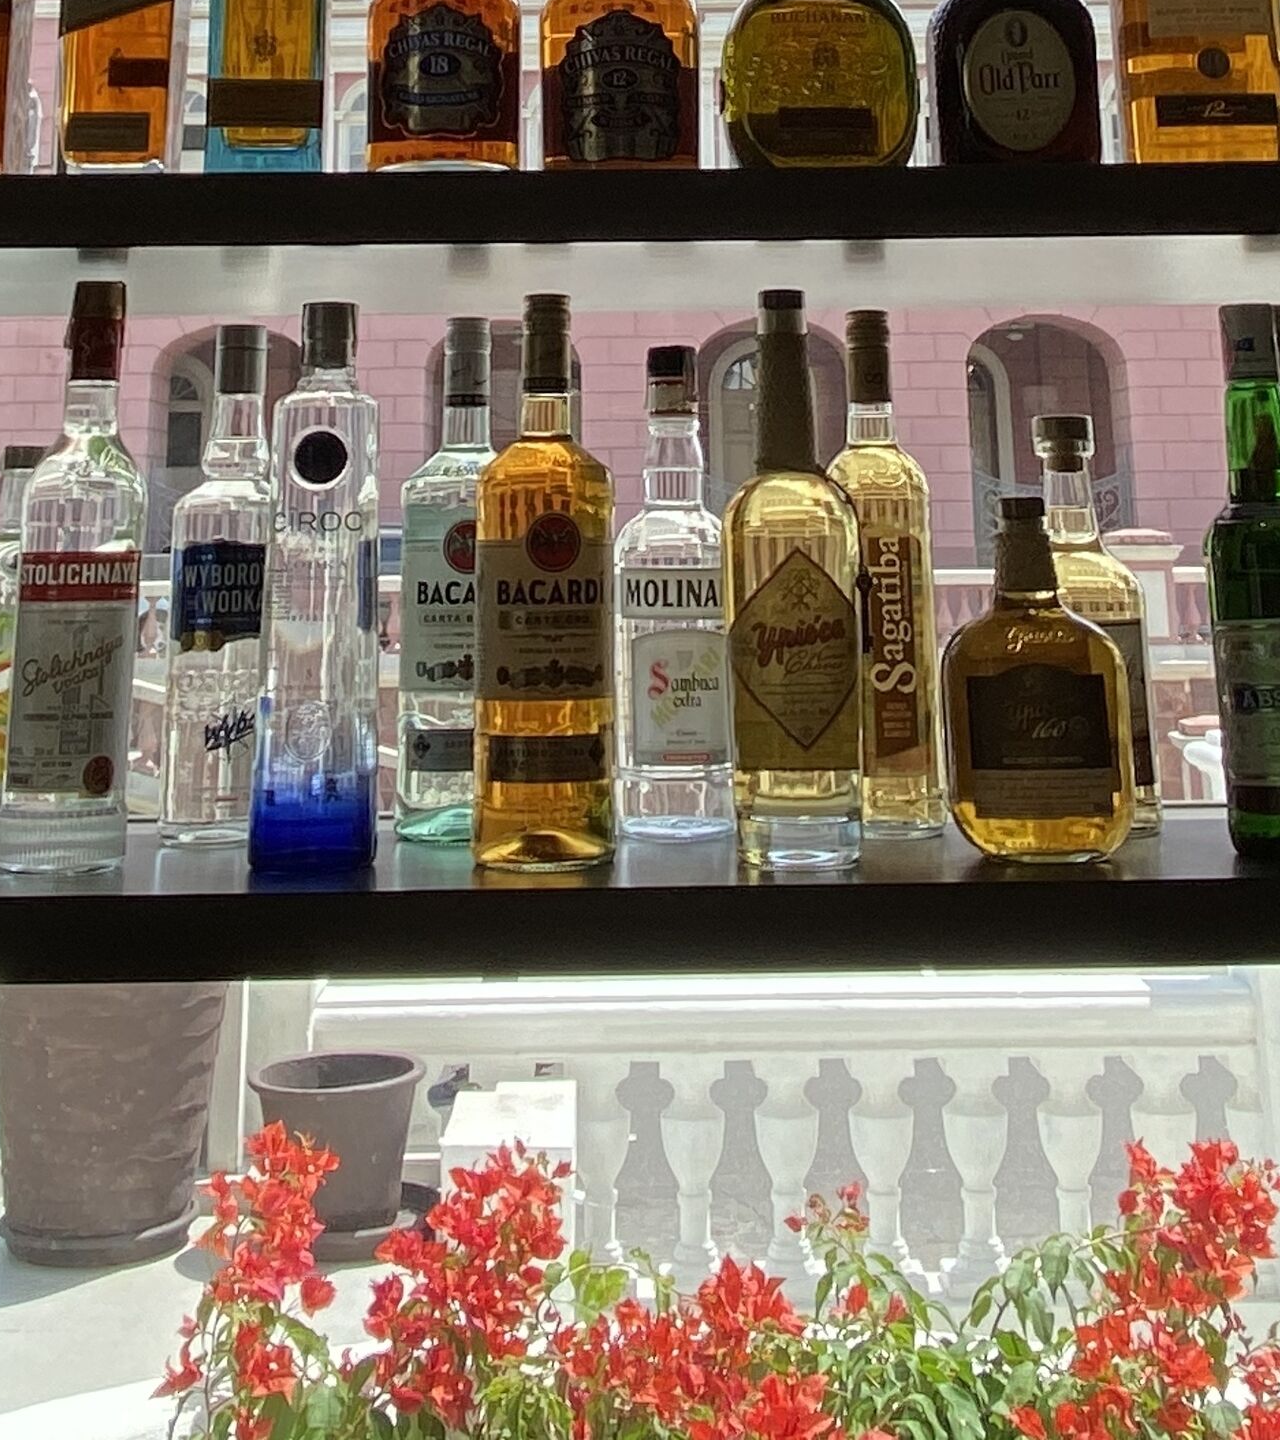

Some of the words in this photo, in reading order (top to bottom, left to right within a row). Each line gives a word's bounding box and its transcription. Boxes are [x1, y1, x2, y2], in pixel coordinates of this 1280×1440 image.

[388, 31, 442, 58] CHIVAS
[442, 32, 493, 58] REGAL
[428, 54, 449, 74] 18
[564, 46, 622, 74] CHIVAS
[624, 45, 677, 73] REGAL
[979, 63, 1015, 97] Old
[1017, 61, 1062, 95] Parr
[423, 613, 461, 624] CARTA
[869, 534, 917, 695] Sagatiba
